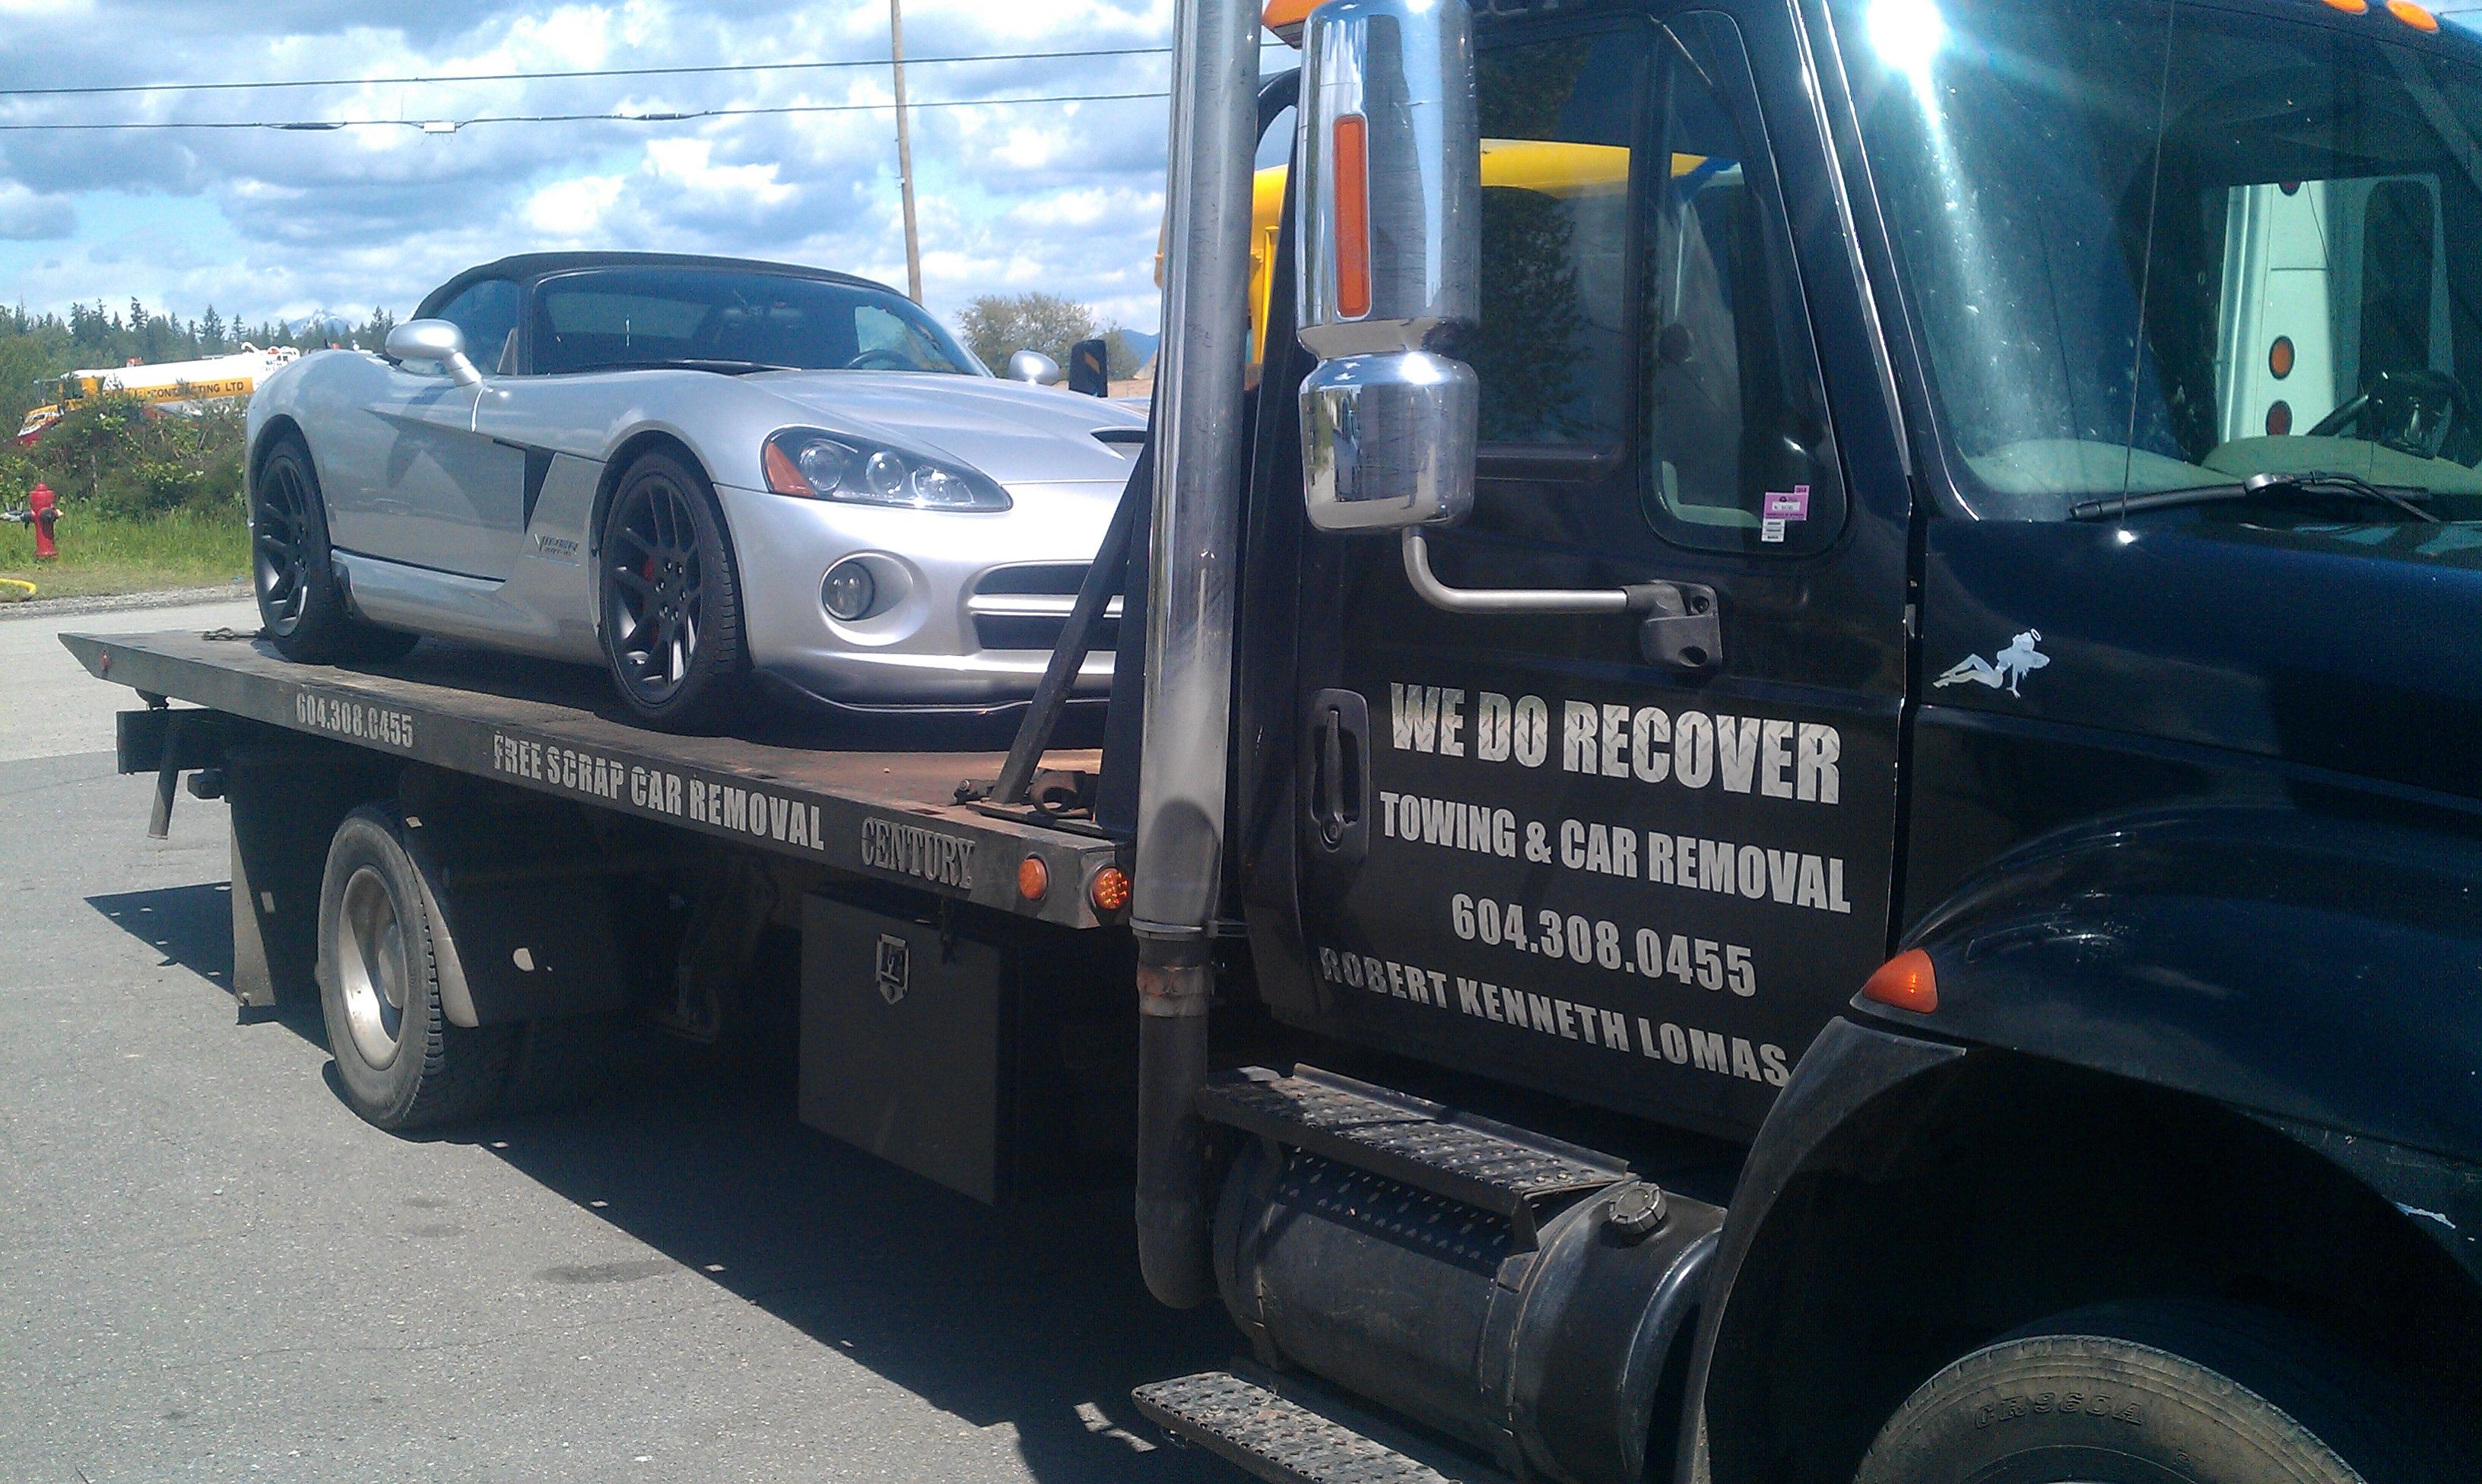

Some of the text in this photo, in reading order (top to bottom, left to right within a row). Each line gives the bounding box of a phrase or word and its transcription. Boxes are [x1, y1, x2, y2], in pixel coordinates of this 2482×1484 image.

[151, 384, 221, 398] CONTTING
[225, 382, 244, 392] LTD
[296, 693, 414, 749] 604.308.0455
[1390, 682, 1842, 805] WE DO RECOVER
[493, 731, 825, 851] FREE SCRAP CAR REMOVAL
[861, 816, 976, 890] CENTURY
[1379, 792, 1851, 914] TOWING & CAR REMOVAL
[1451, 893, 1757, 998] 604.308.0455
[1319, 947, 1791, 1088] ROBERT KENNETH LOMAS
